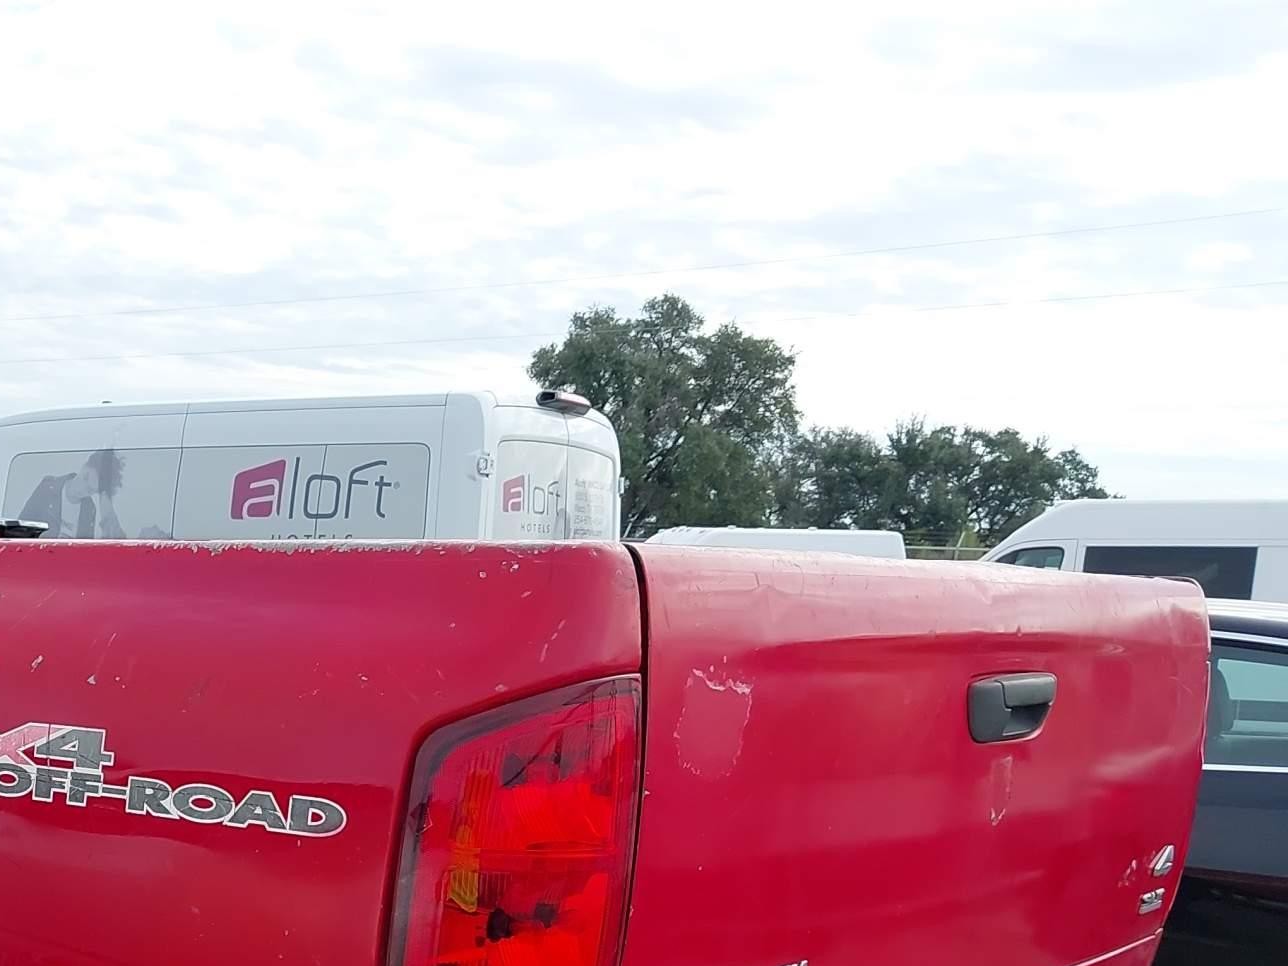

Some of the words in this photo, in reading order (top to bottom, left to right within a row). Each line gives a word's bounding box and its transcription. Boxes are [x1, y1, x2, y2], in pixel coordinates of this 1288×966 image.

[230, 456, 392, 520] aloft
[502, 473, 561, 517] aloft
[520, 523, 551, 534] HOTELS
